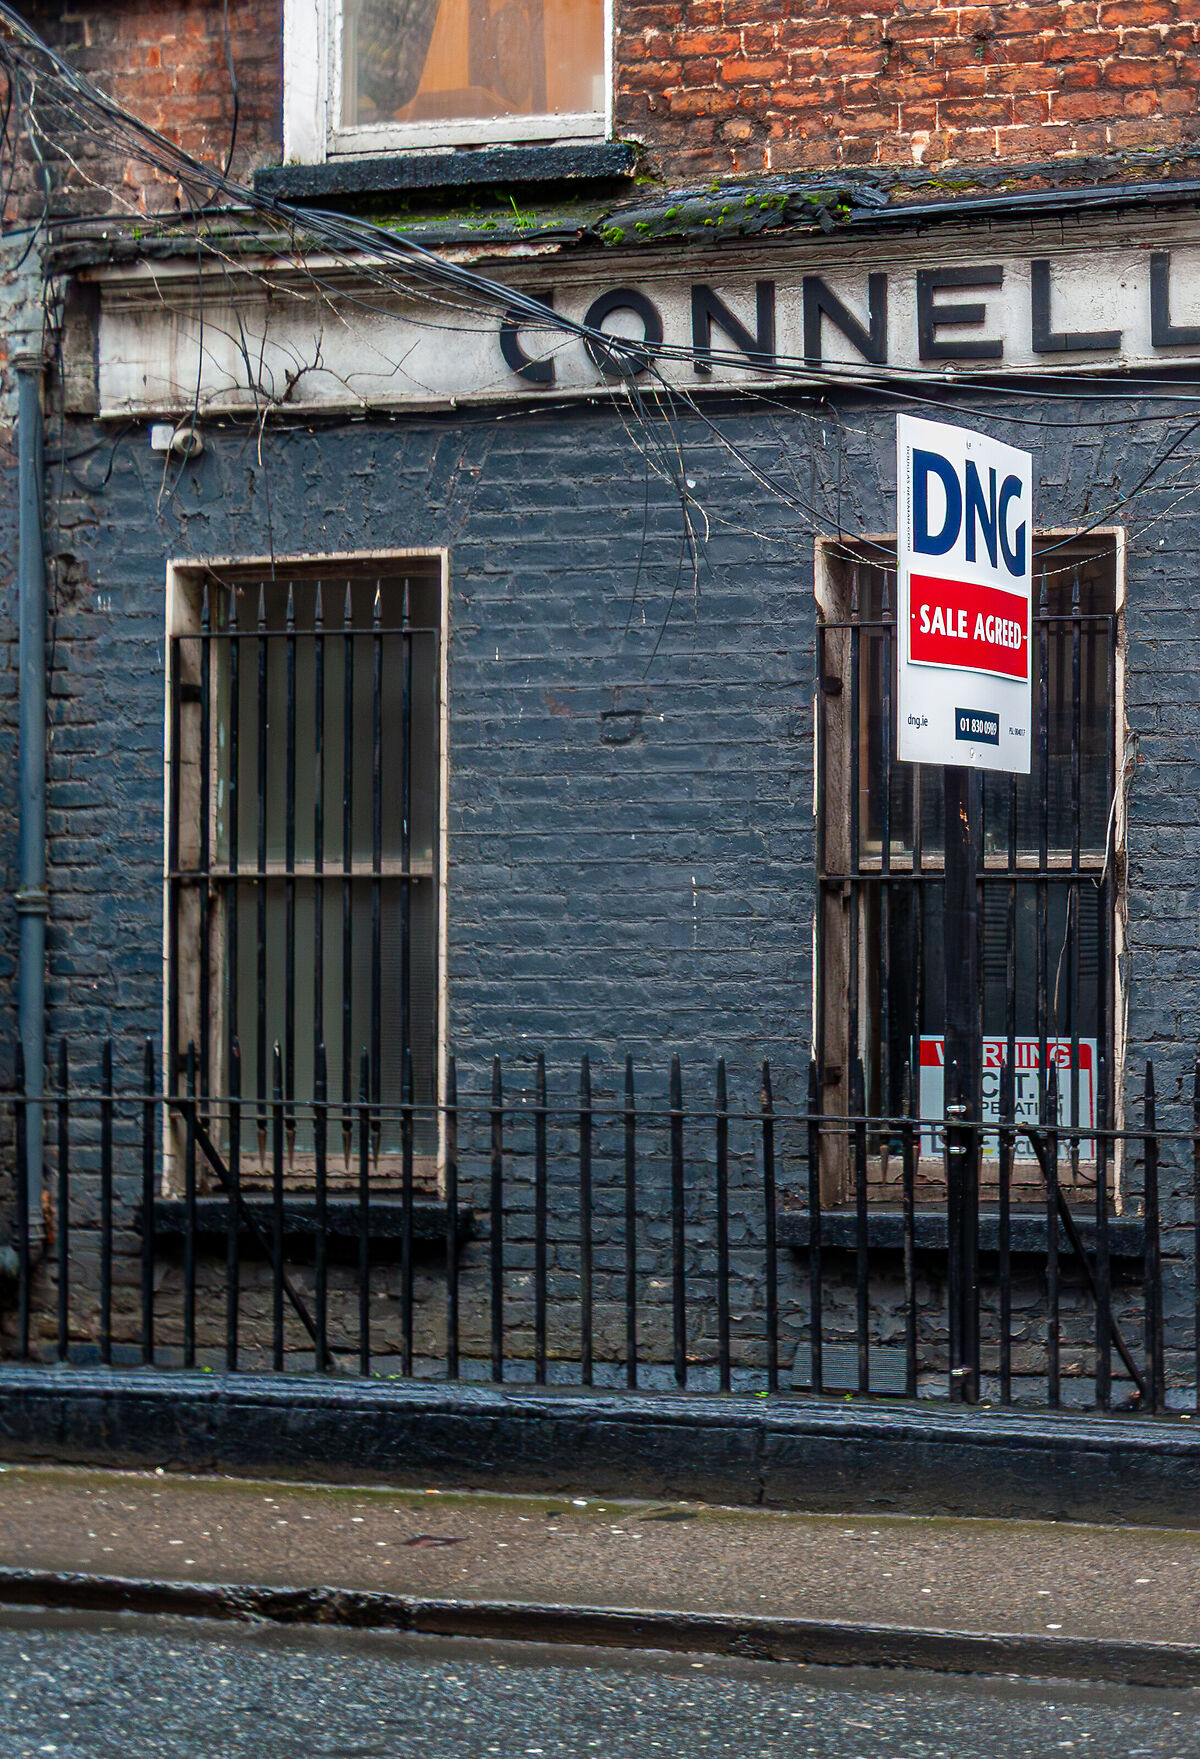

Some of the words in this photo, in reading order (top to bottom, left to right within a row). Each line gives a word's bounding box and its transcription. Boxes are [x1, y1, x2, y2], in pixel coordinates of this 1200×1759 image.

[912, 447, 1026, 577] DNG
[920, 603, 969, 639] SALE
[973, 612, 1022, 650] AGREED
[907, 713, 928, 729] dng.ie
[960, 717, 970, 732] 01
[971, 718, 984, 734] 830
